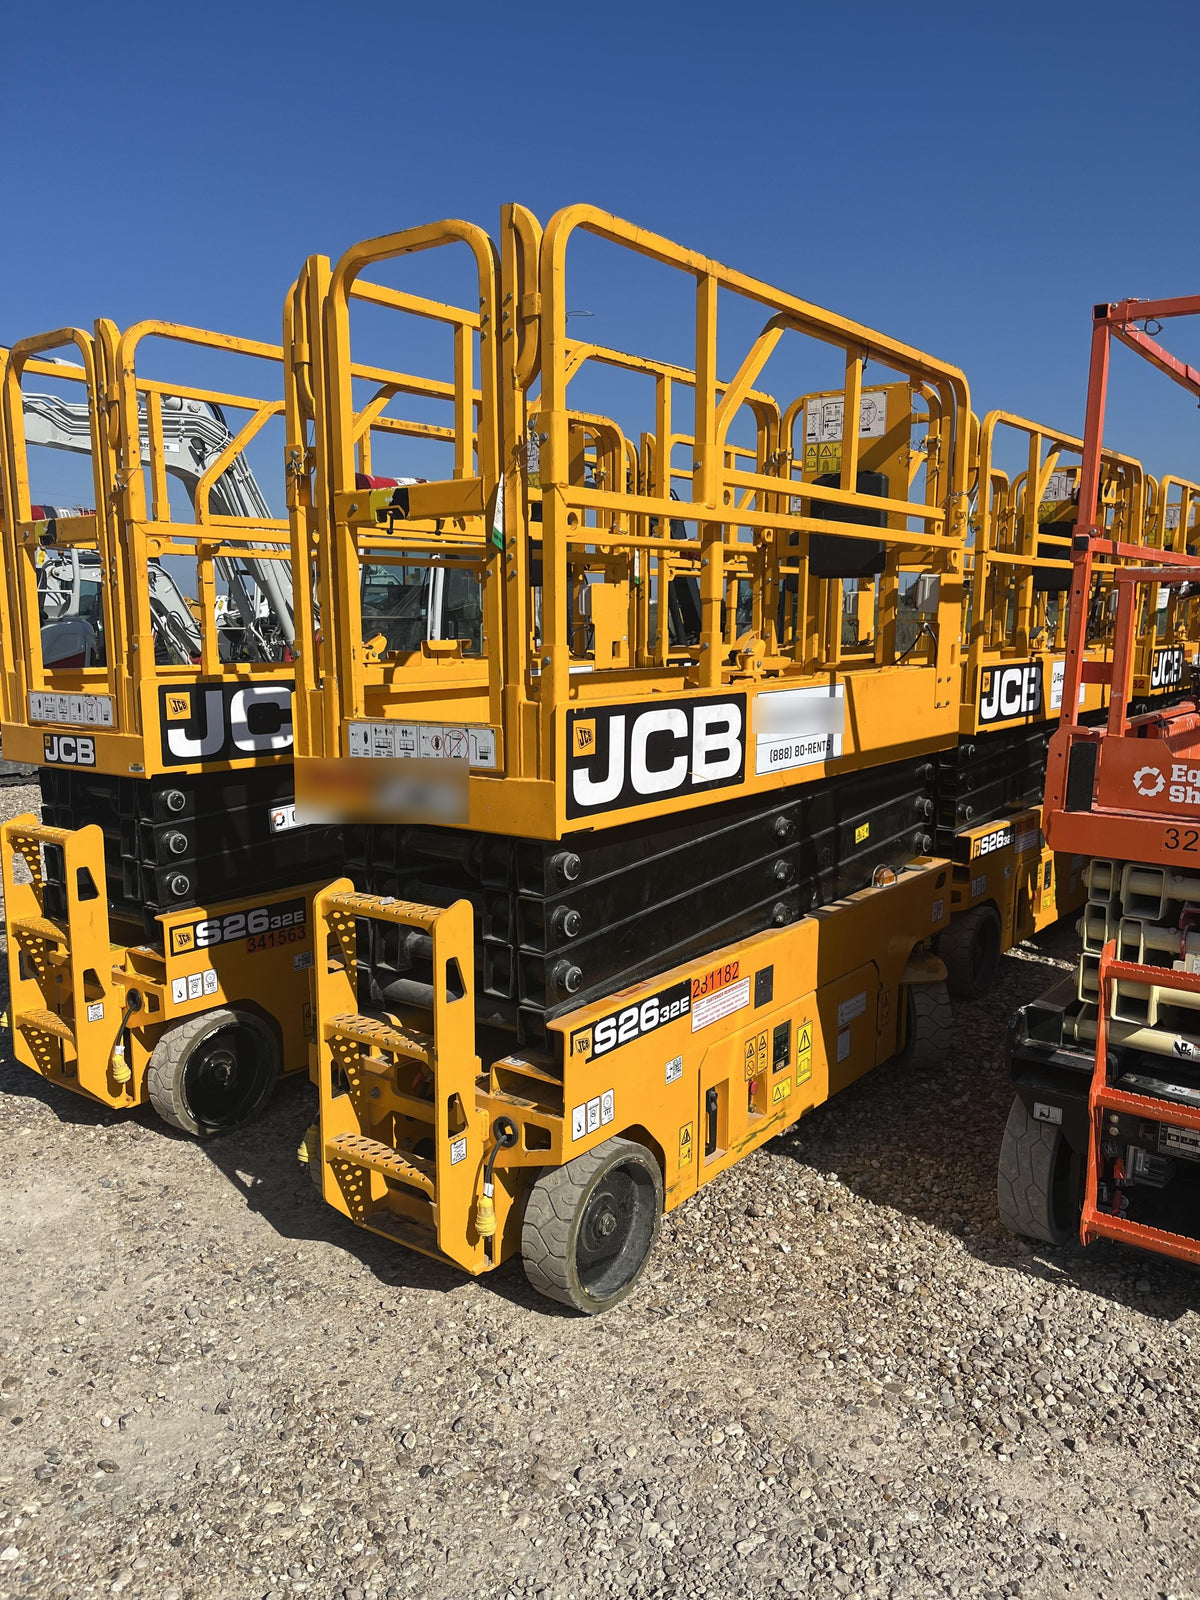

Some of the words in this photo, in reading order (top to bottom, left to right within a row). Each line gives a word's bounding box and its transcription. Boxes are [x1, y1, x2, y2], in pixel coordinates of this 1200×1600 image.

[1152, 650, 1182, 686] JCB
[981, 667, 1041, 720] JCB
[173, 700, 188, 713] JCB
[45, 736, 95, 764] JCB
[579, 729, 593, 747] JCB
[573, 703, 742, 806] JCB
[770, 746, 792, 763] (888)
[794, 739, 831, 757] 80-RENTS
[178, 933, 191, 946] JCB
[247, 926, 306, 953] 341563
[578, 1040, 590, 1053] JCB
